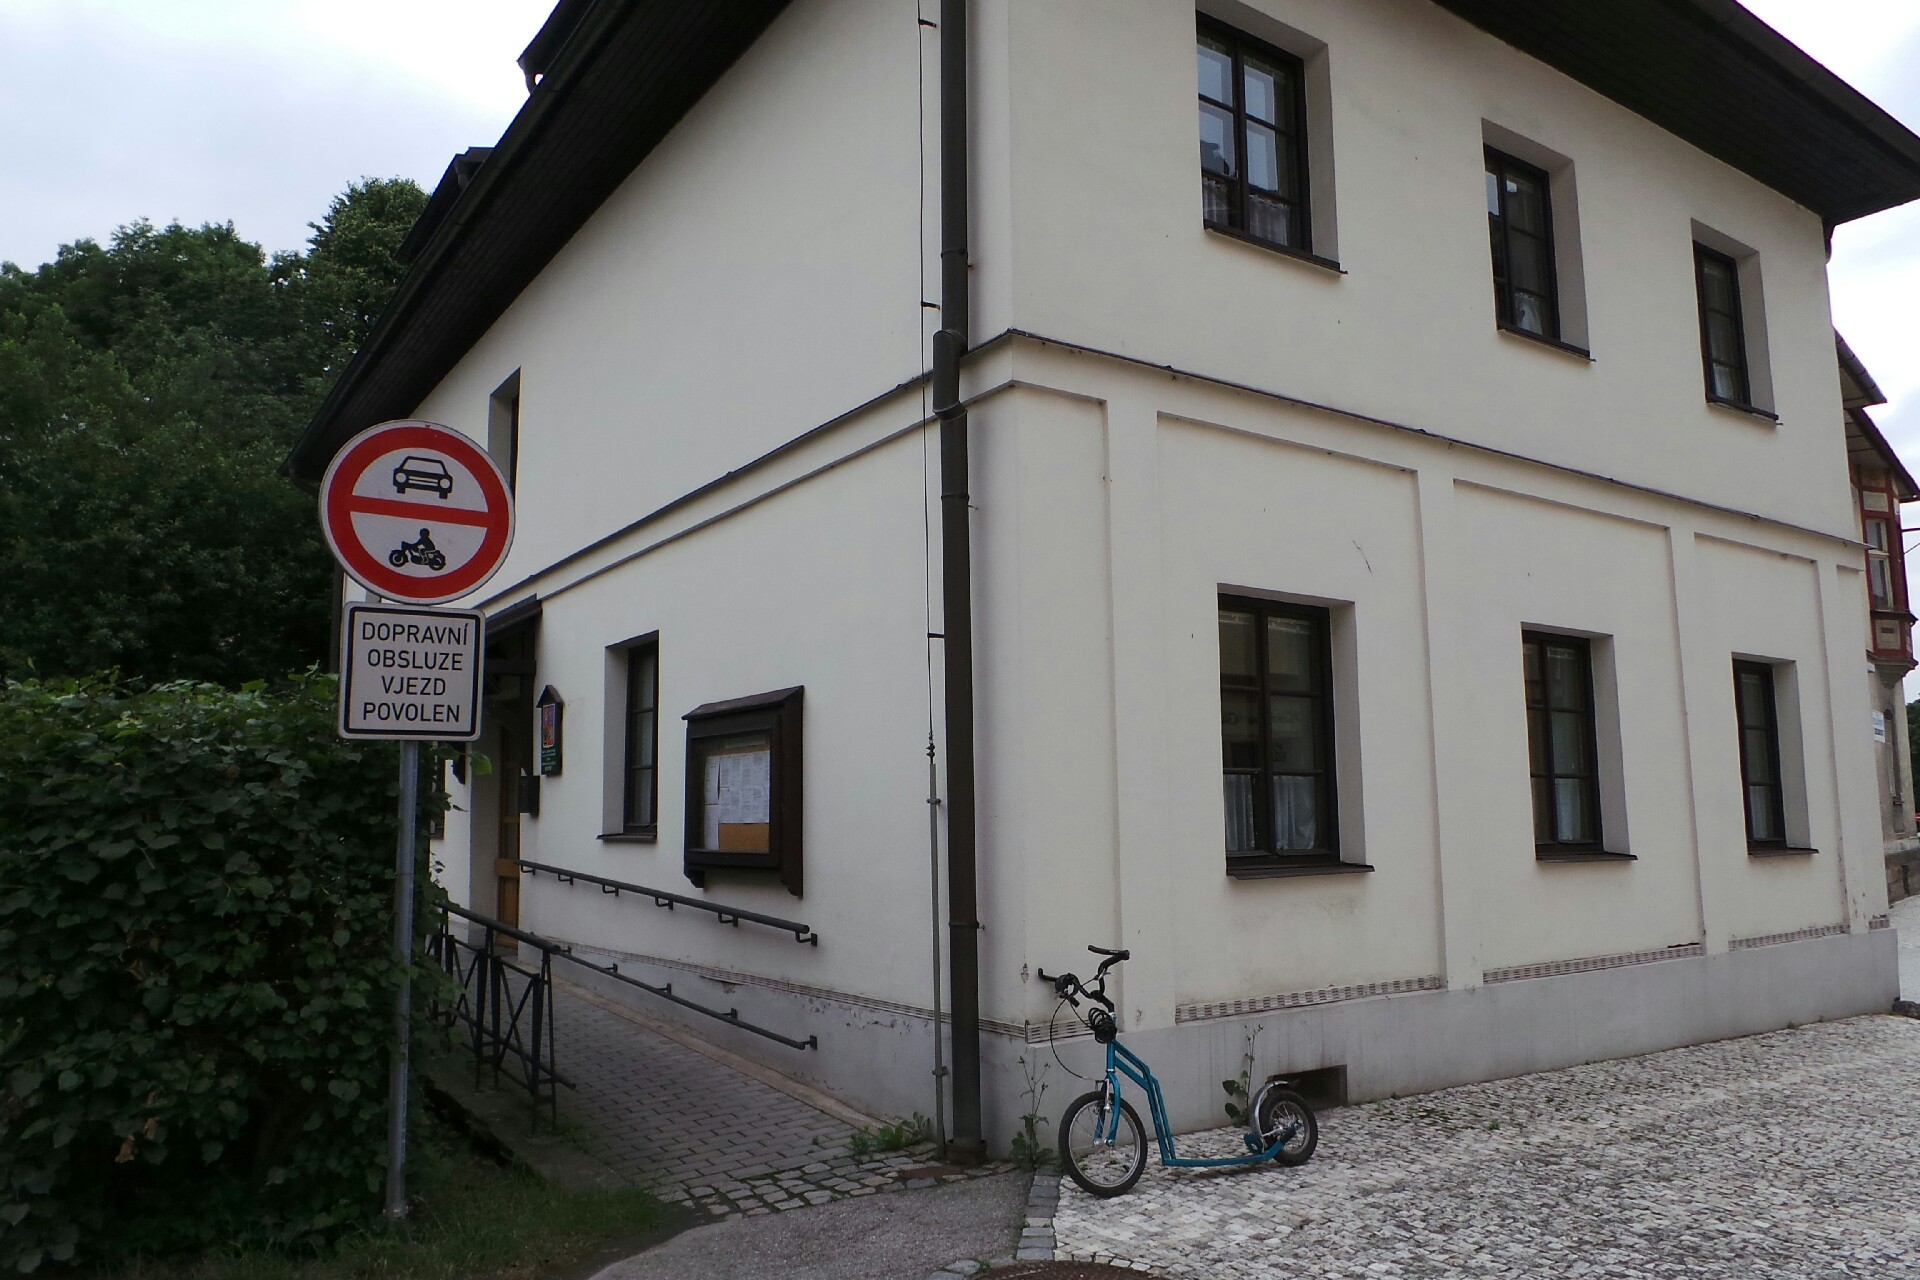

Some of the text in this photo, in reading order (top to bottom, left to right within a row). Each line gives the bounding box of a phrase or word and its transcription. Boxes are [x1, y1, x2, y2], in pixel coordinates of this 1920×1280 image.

[362, 622, 469, 645] DOPRAVNÍ
[367, 649, 464, 671] OBSLUZE
[381, 675, 446, 696] VJEZD
[362, 702, 460, 723] POVOLEN
